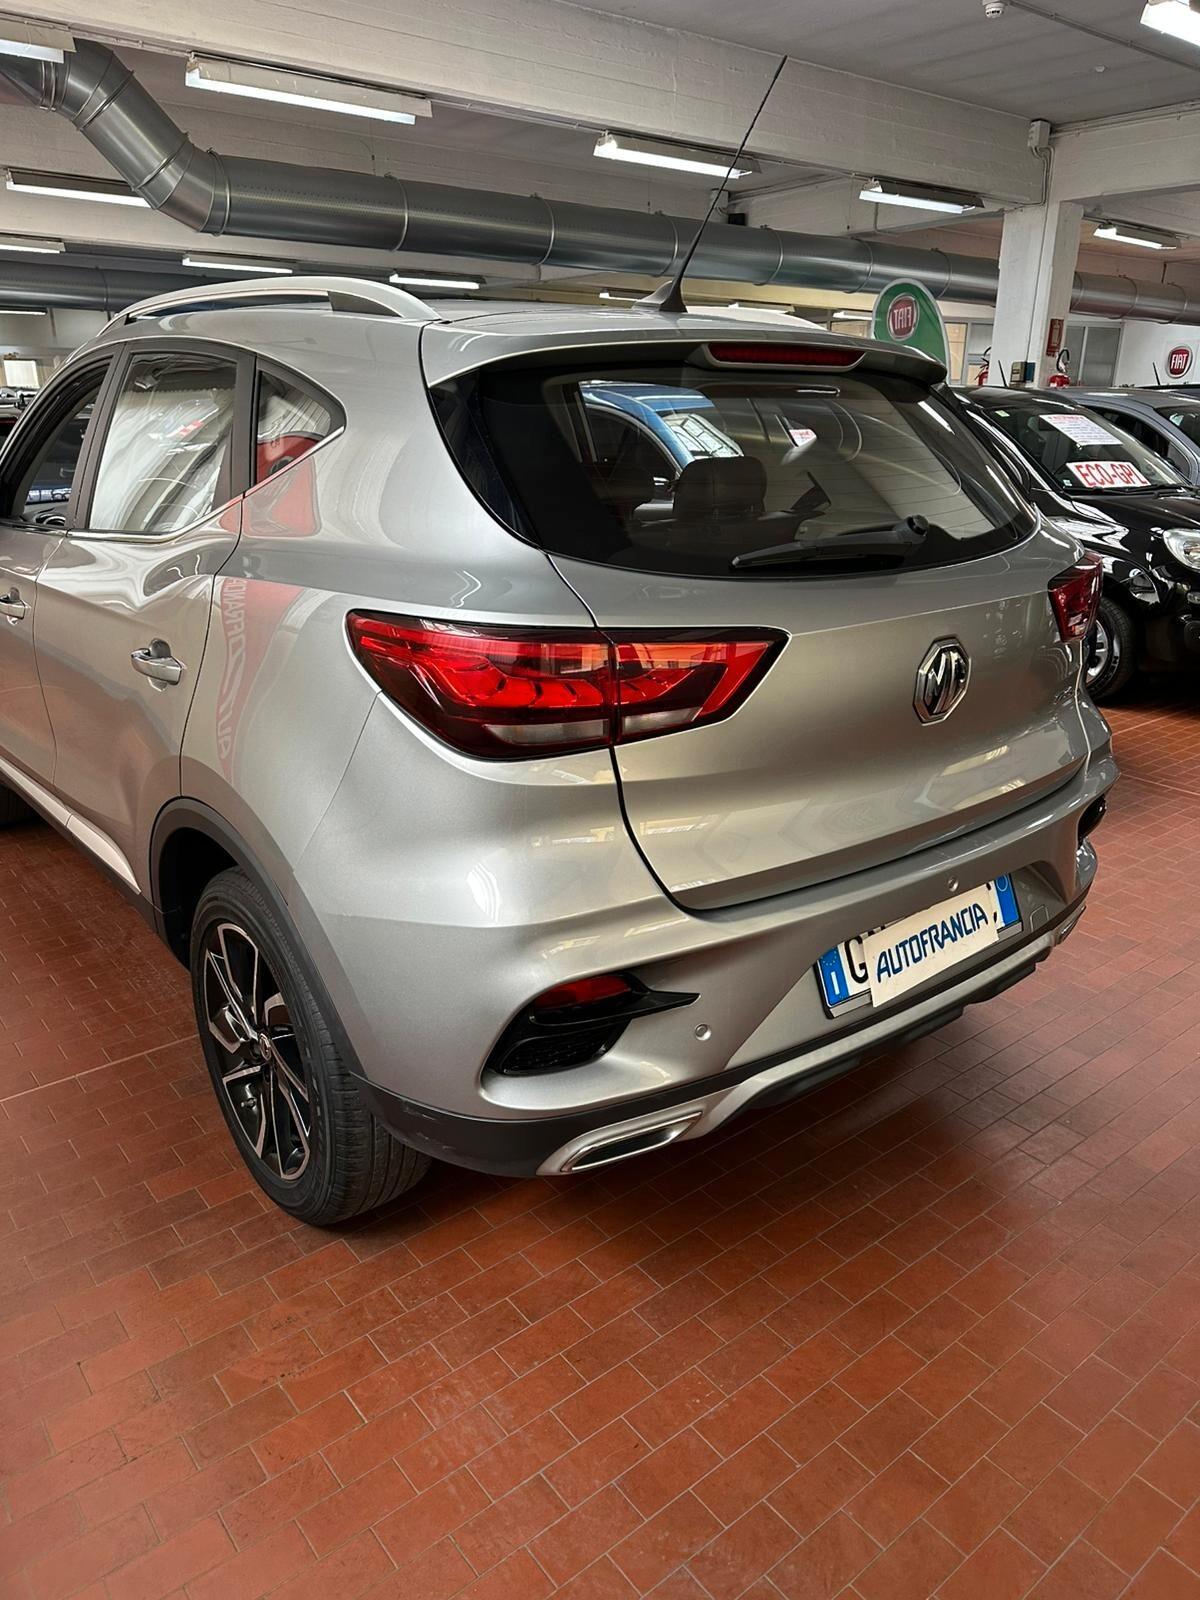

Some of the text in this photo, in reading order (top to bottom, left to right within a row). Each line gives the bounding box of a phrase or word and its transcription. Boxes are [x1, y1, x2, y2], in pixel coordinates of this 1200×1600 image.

[1170, 353, 1188, 369] FIAT
[1074, 463, 1149, 487] ECO-GPL
[923, 650, 968, 714] MG
[876, 902, 989, 983] AUTOFRANCIA
